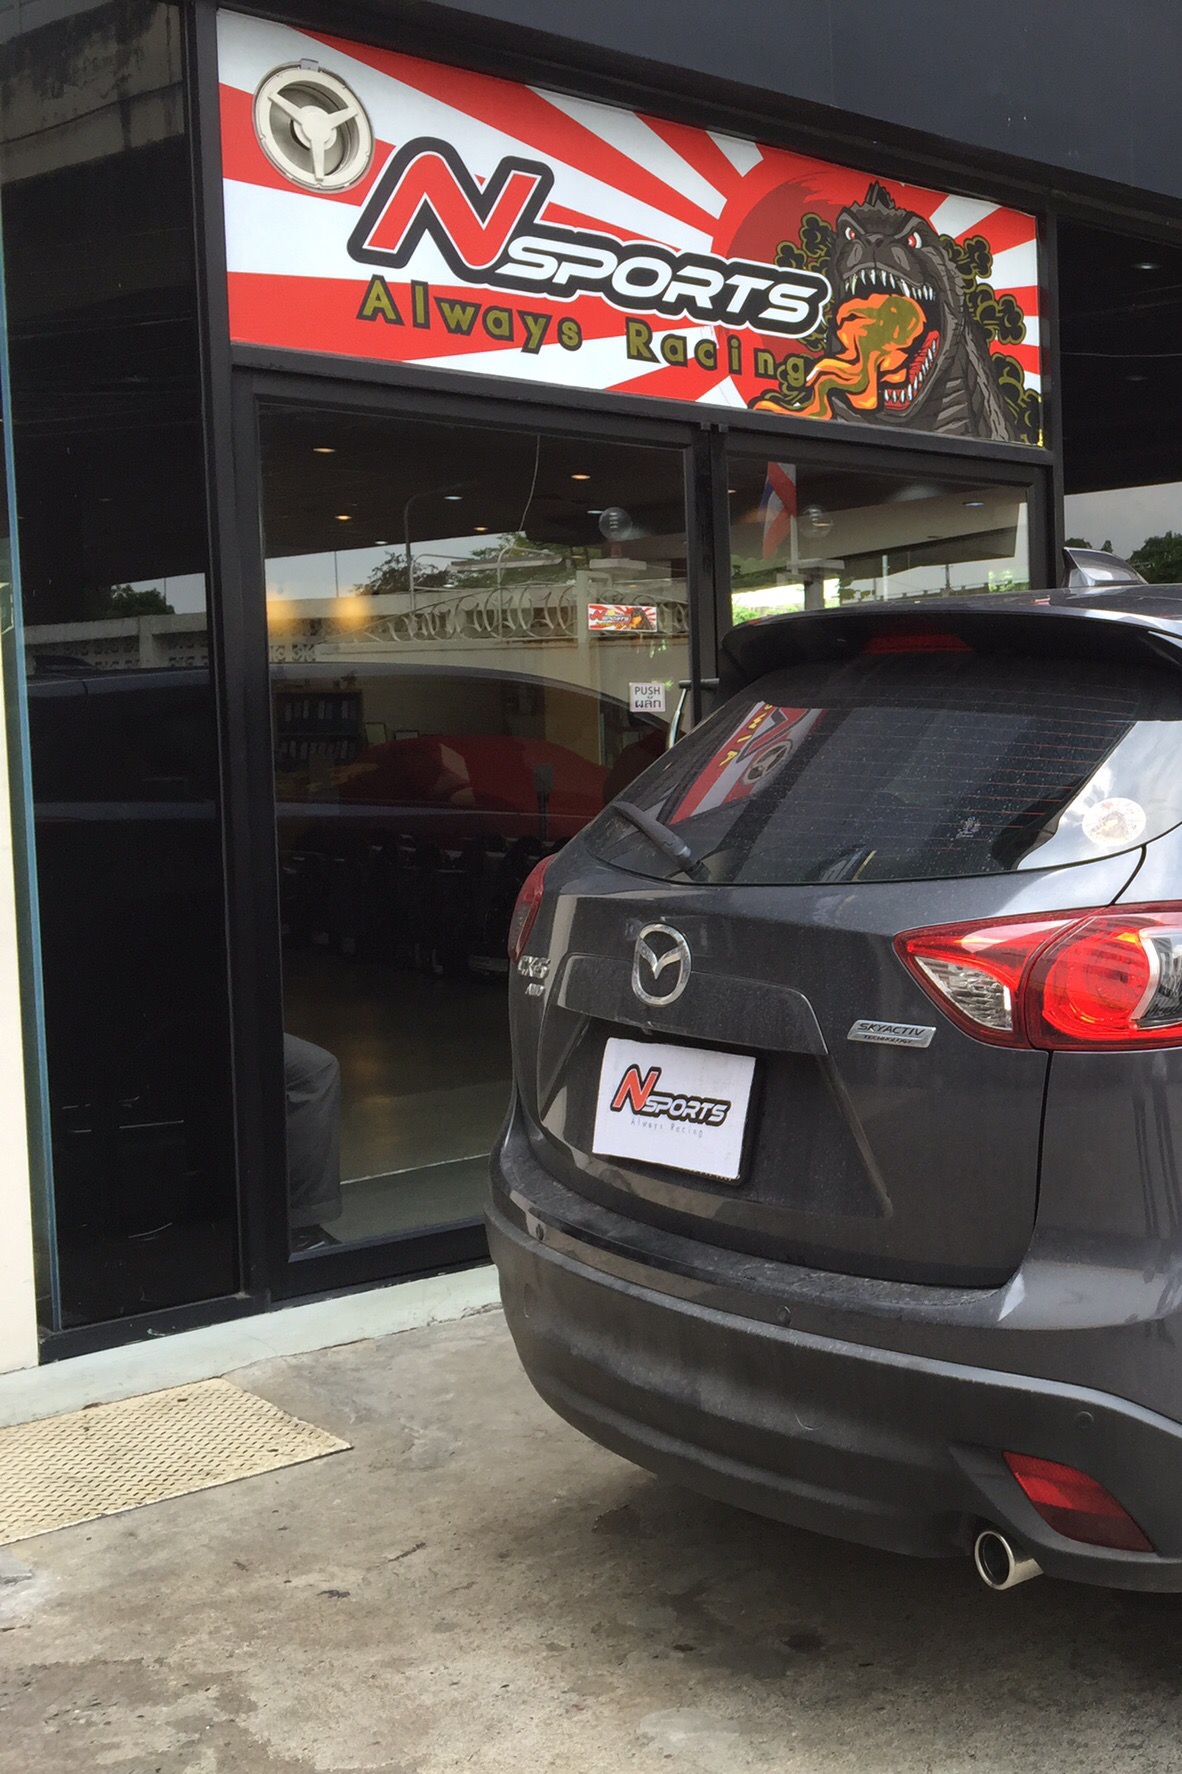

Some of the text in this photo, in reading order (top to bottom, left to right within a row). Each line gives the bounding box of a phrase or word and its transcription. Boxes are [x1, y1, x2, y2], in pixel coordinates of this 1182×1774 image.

[356, 274, 806, 389] Always Racing
[634, 685, 661, 696] PUSH
[634, 696, 662, 709] ผลัก
[857, 1022, 926, 1036] SKYACTIV
[630, 1117, 703, 1138] Always Racing
